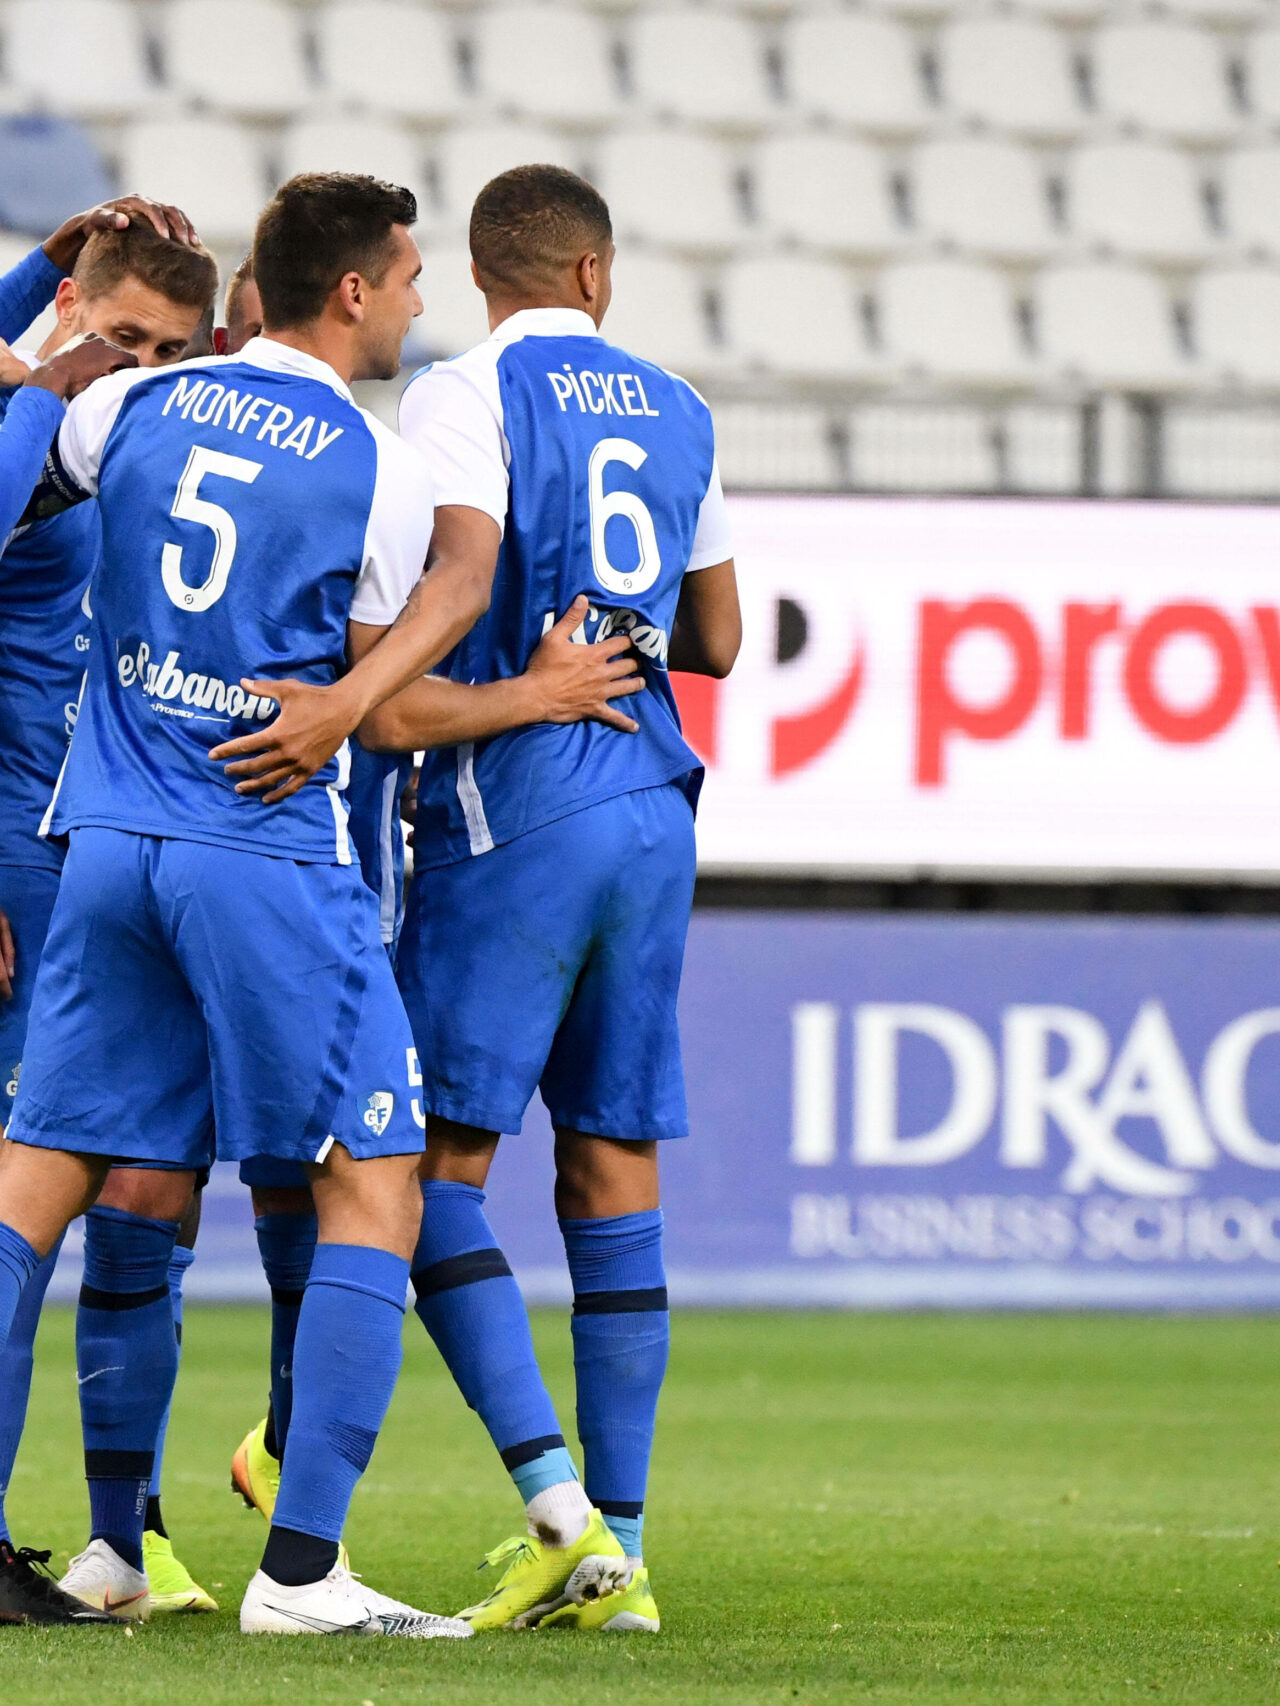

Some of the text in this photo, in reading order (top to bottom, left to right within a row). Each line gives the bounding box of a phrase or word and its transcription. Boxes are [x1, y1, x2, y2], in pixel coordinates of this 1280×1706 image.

[161, 376, 344, 461] MONFRAY
[160, 444, 264, 613] 5
[587, 437, 662, 596] 6
[915, 596, 1280, 786] pro
[363, 1107, 388, 1127] GF
[791, 1000, 1280, 1195] IDRAC
